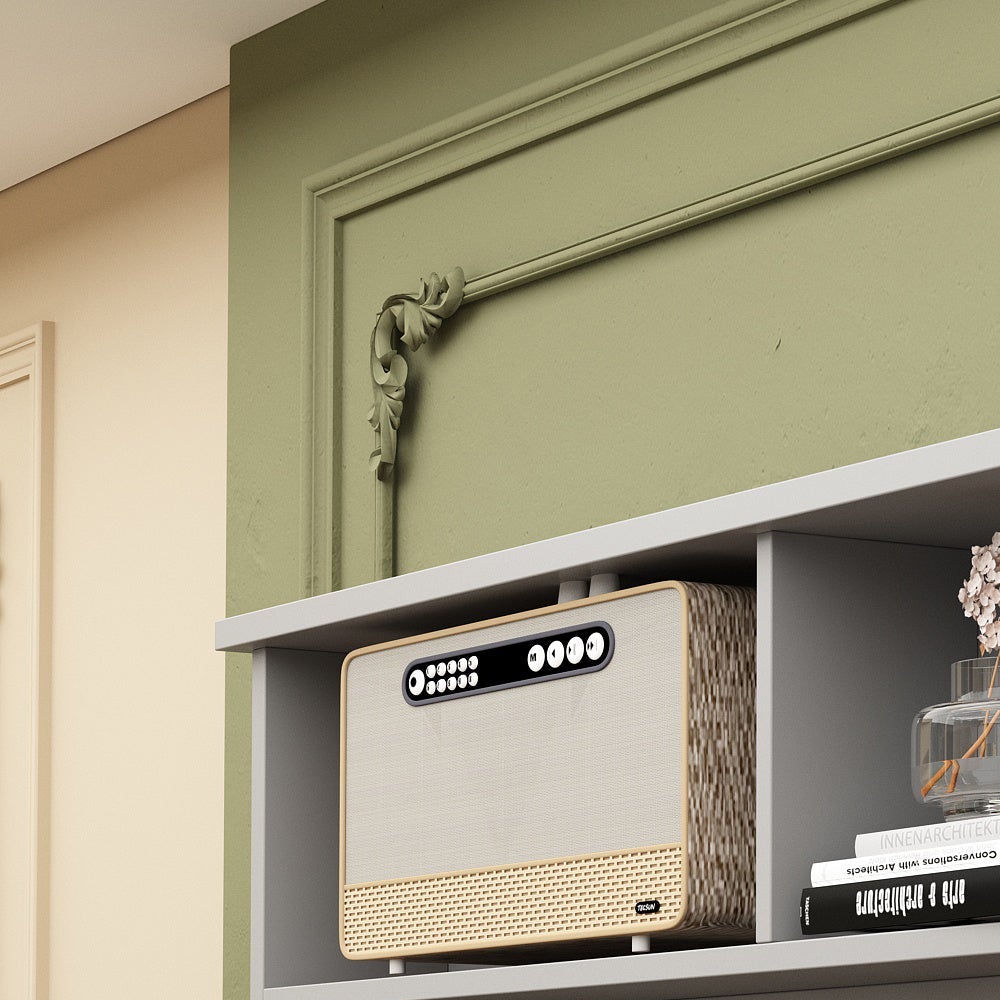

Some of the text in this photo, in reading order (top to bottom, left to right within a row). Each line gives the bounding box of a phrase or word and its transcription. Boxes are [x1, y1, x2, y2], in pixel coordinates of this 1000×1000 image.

[847, 851, 996, 875] Conversations with Architects
[856, 879, 965, 917] arts & architecture
